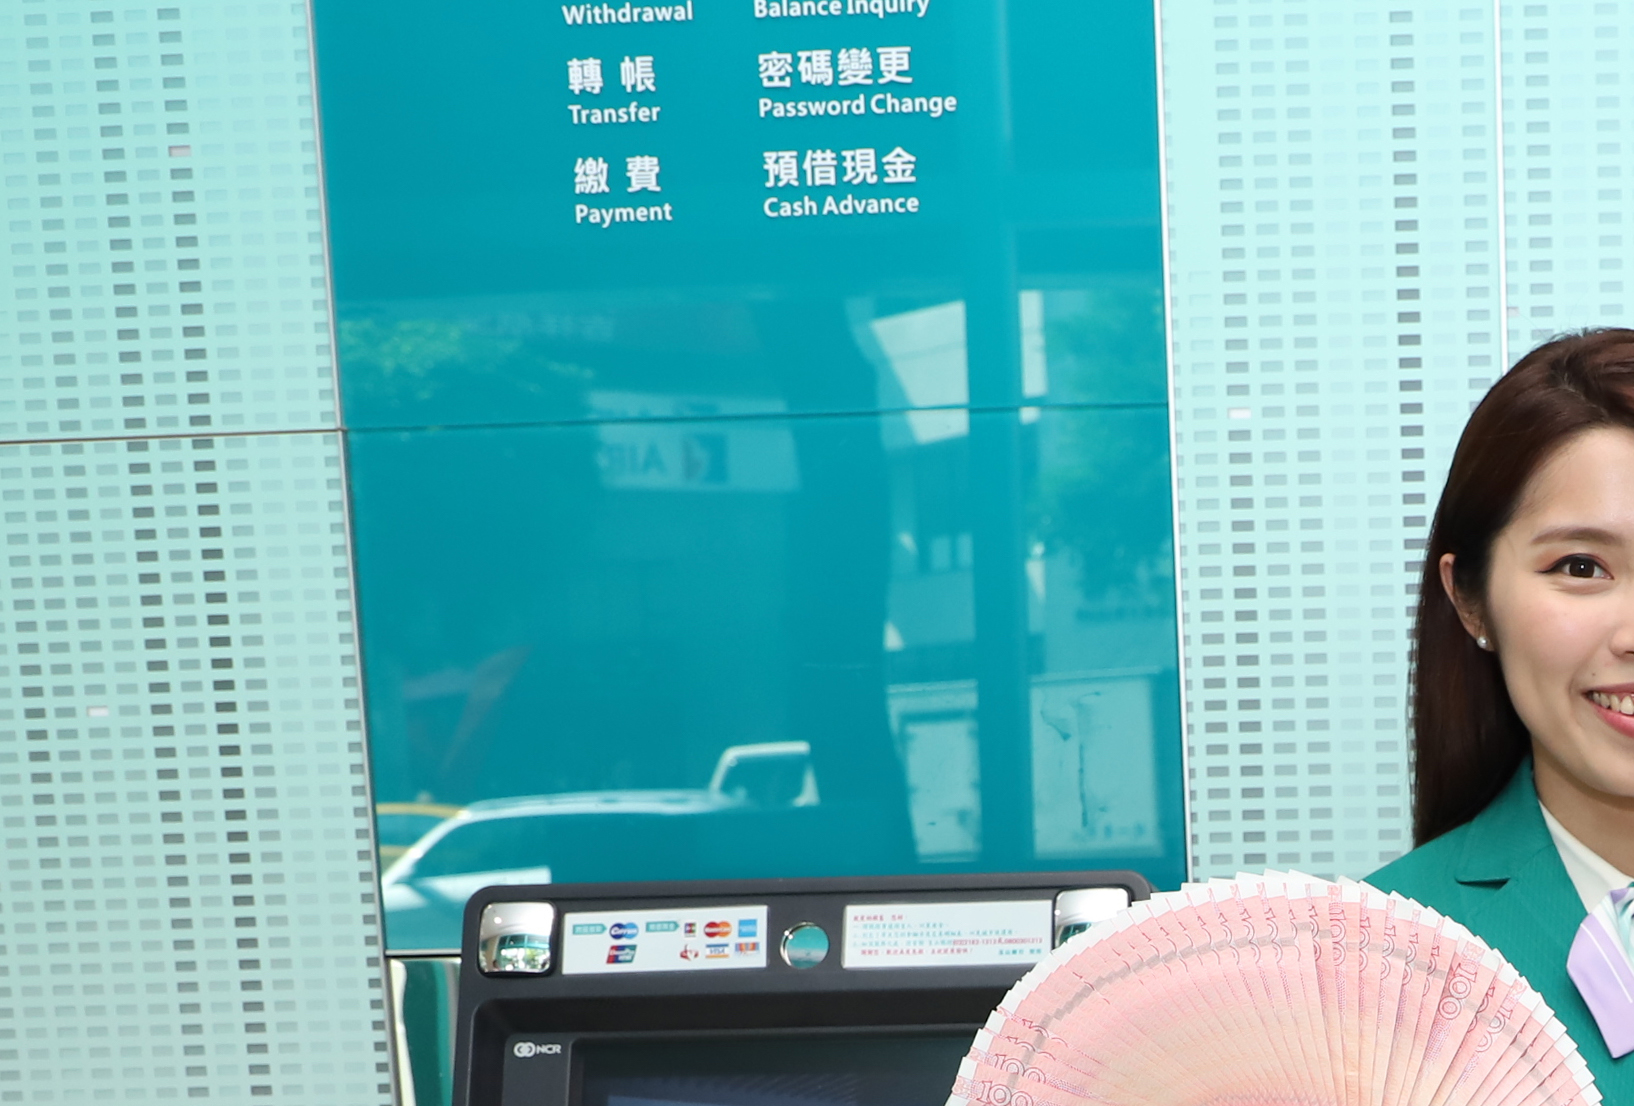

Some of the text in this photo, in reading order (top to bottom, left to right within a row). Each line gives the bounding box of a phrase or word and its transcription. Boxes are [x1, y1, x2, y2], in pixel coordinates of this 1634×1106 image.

[562, 0, 694, 25] Withdrawal
[754, 0, 931, 18] Balance Inquiry
[567, 56, 656, 95] 轉帳
[758, 46, 913, 88] 密碼變更
[568, 102, 660, 125] Transfer
[758, 94, 957, 118] Password Change
[574, 155, 661, 195] 繳費
[763, 147, 917, 189] 預借現金
[575, 203, 672, 228] Payment
[763, 195, 919, 218] Cash Advance
[1437, 962, 1478, 1021] 100
[534, 1043, 561, 1055] NCR
